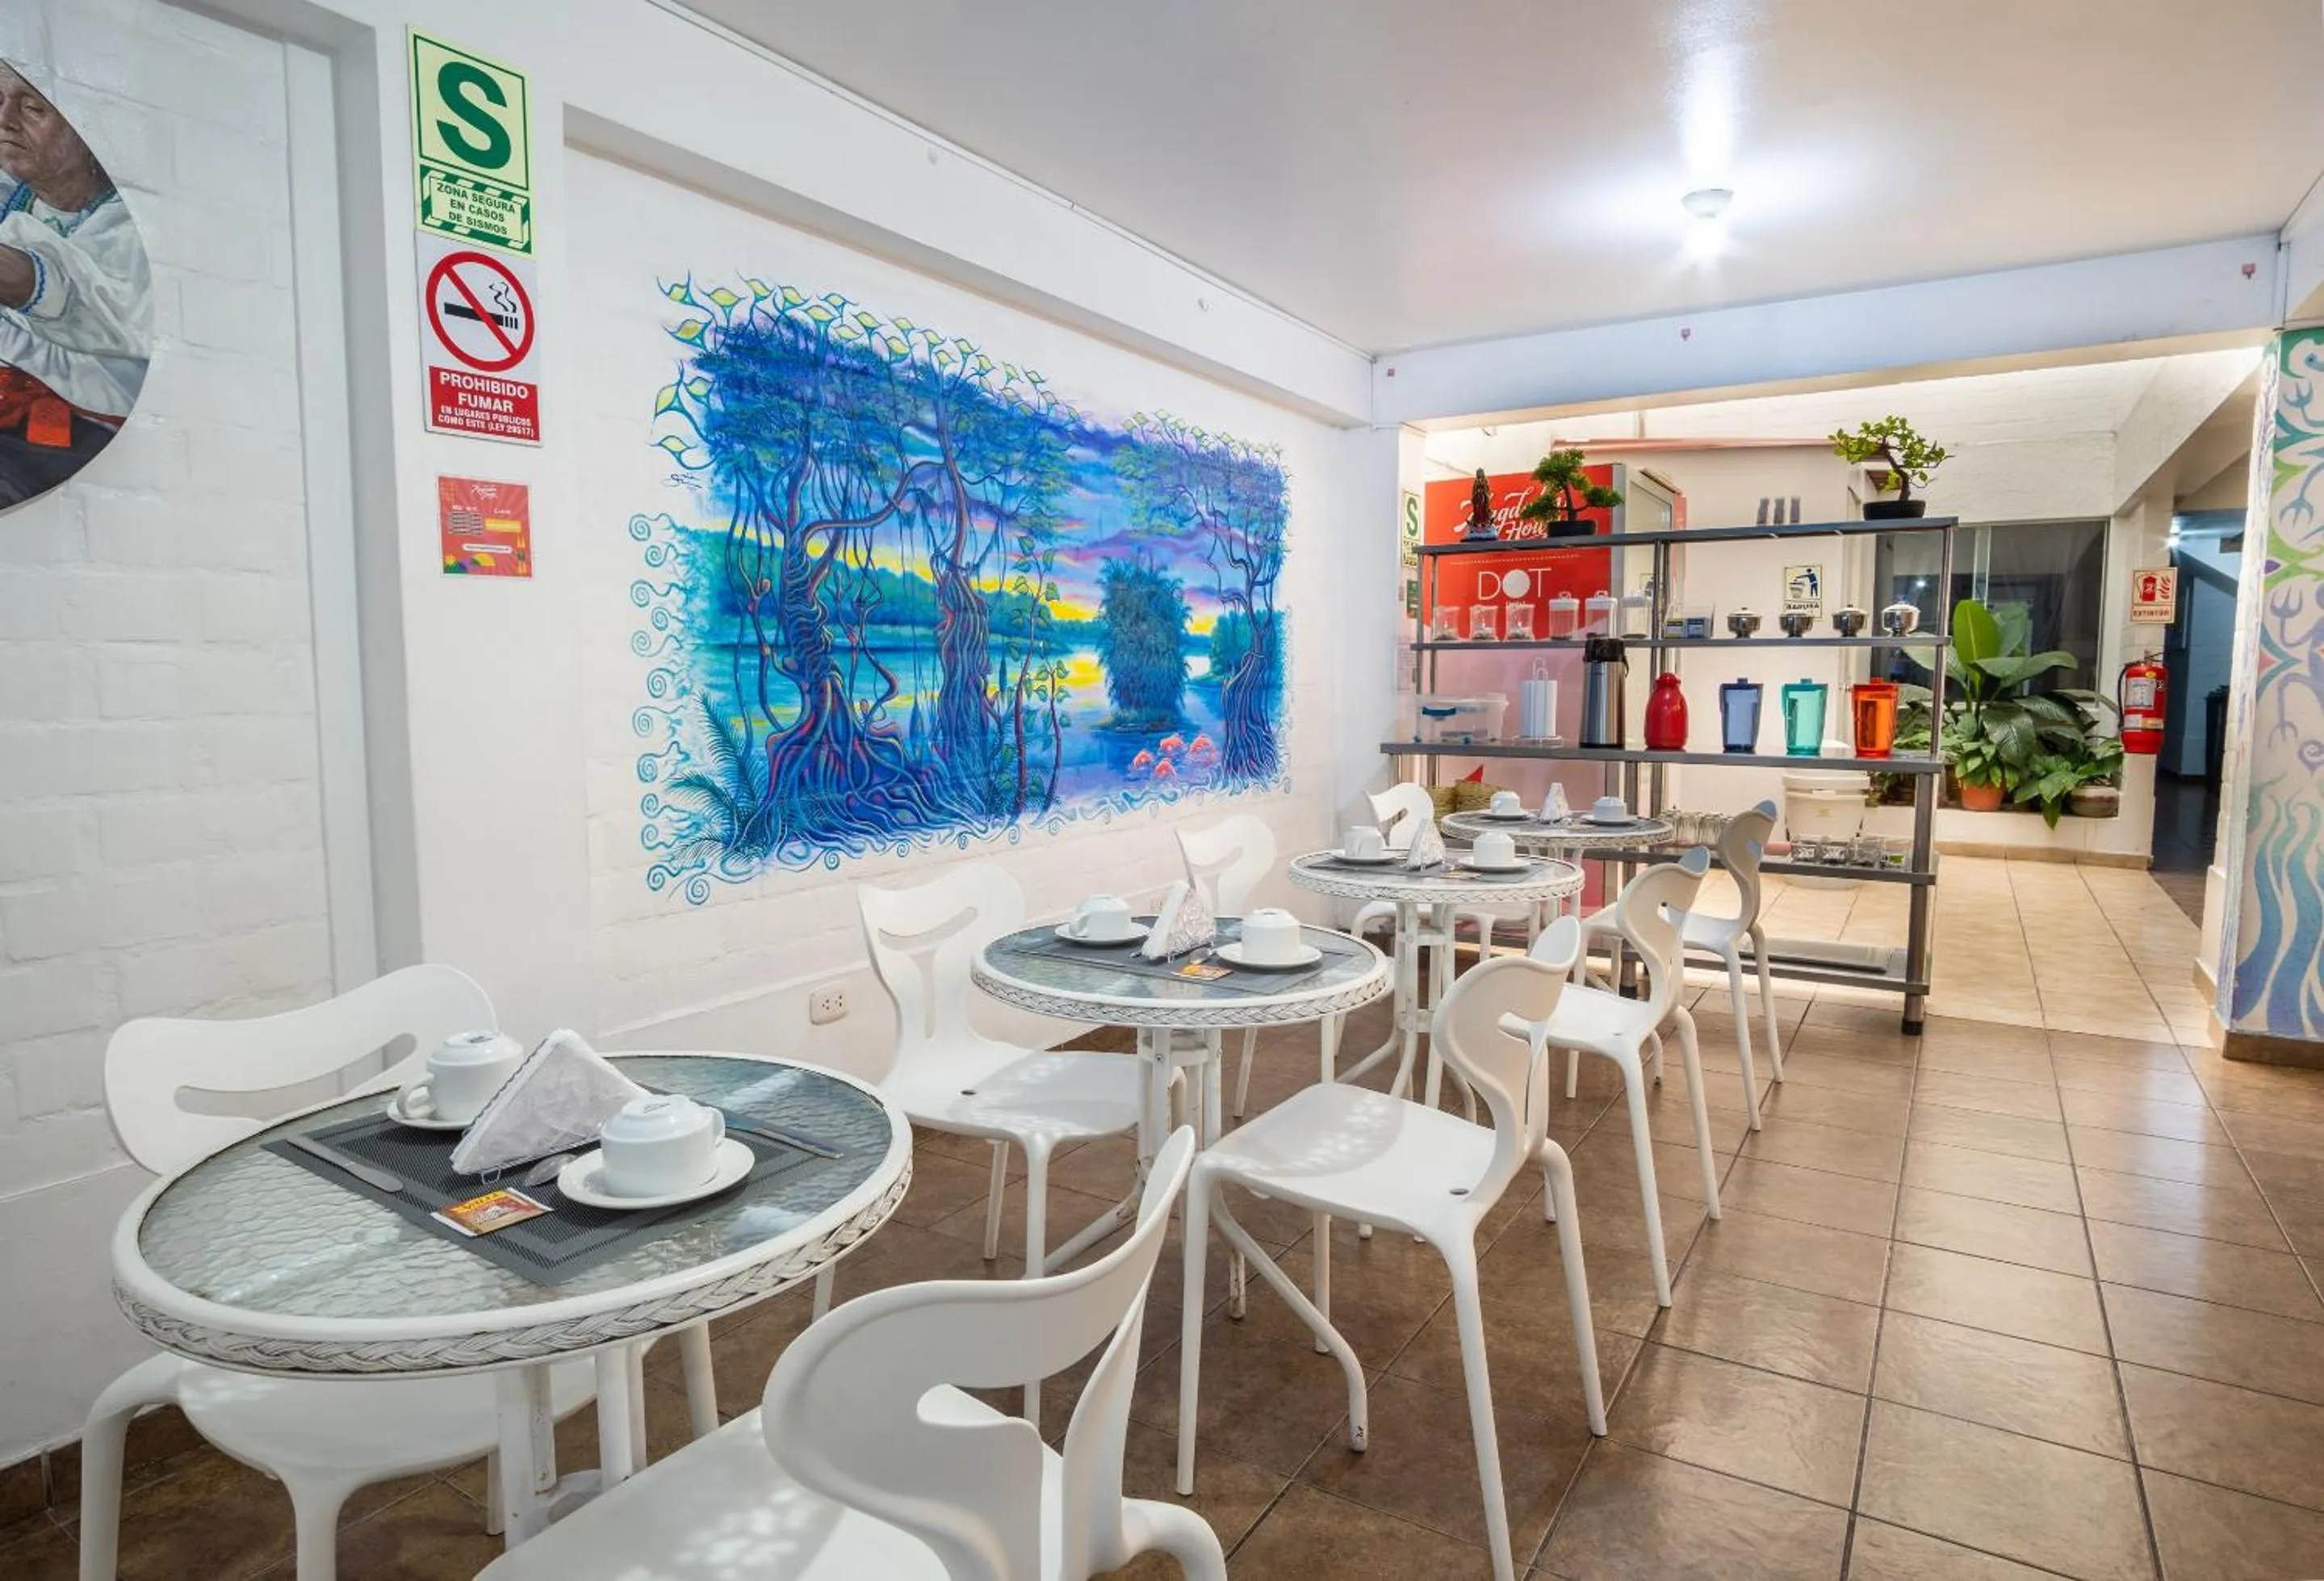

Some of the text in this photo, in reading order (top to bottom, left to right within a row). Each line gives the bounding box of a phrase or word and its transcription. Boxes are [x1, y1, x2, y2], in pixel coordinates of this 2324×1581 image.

[437, 61, 511, 170] S
[437, 182, 515, 213] ZONA SEGURA
[450, 199, 505, 222] EN CASOS
[448, 211, 508, 235] DE SISMOS
[439, 371, 529, 399] PROHIBIDO
[441, 405, 452, 414] EN
[454, 407, 491, 421] LUGARES
[458, 392, 513, 413] FUMAR
[438, 414, 464, 426] COMO
[466, 418, 485, 429] ESTE
[1406, 497, 1418, 537] S
